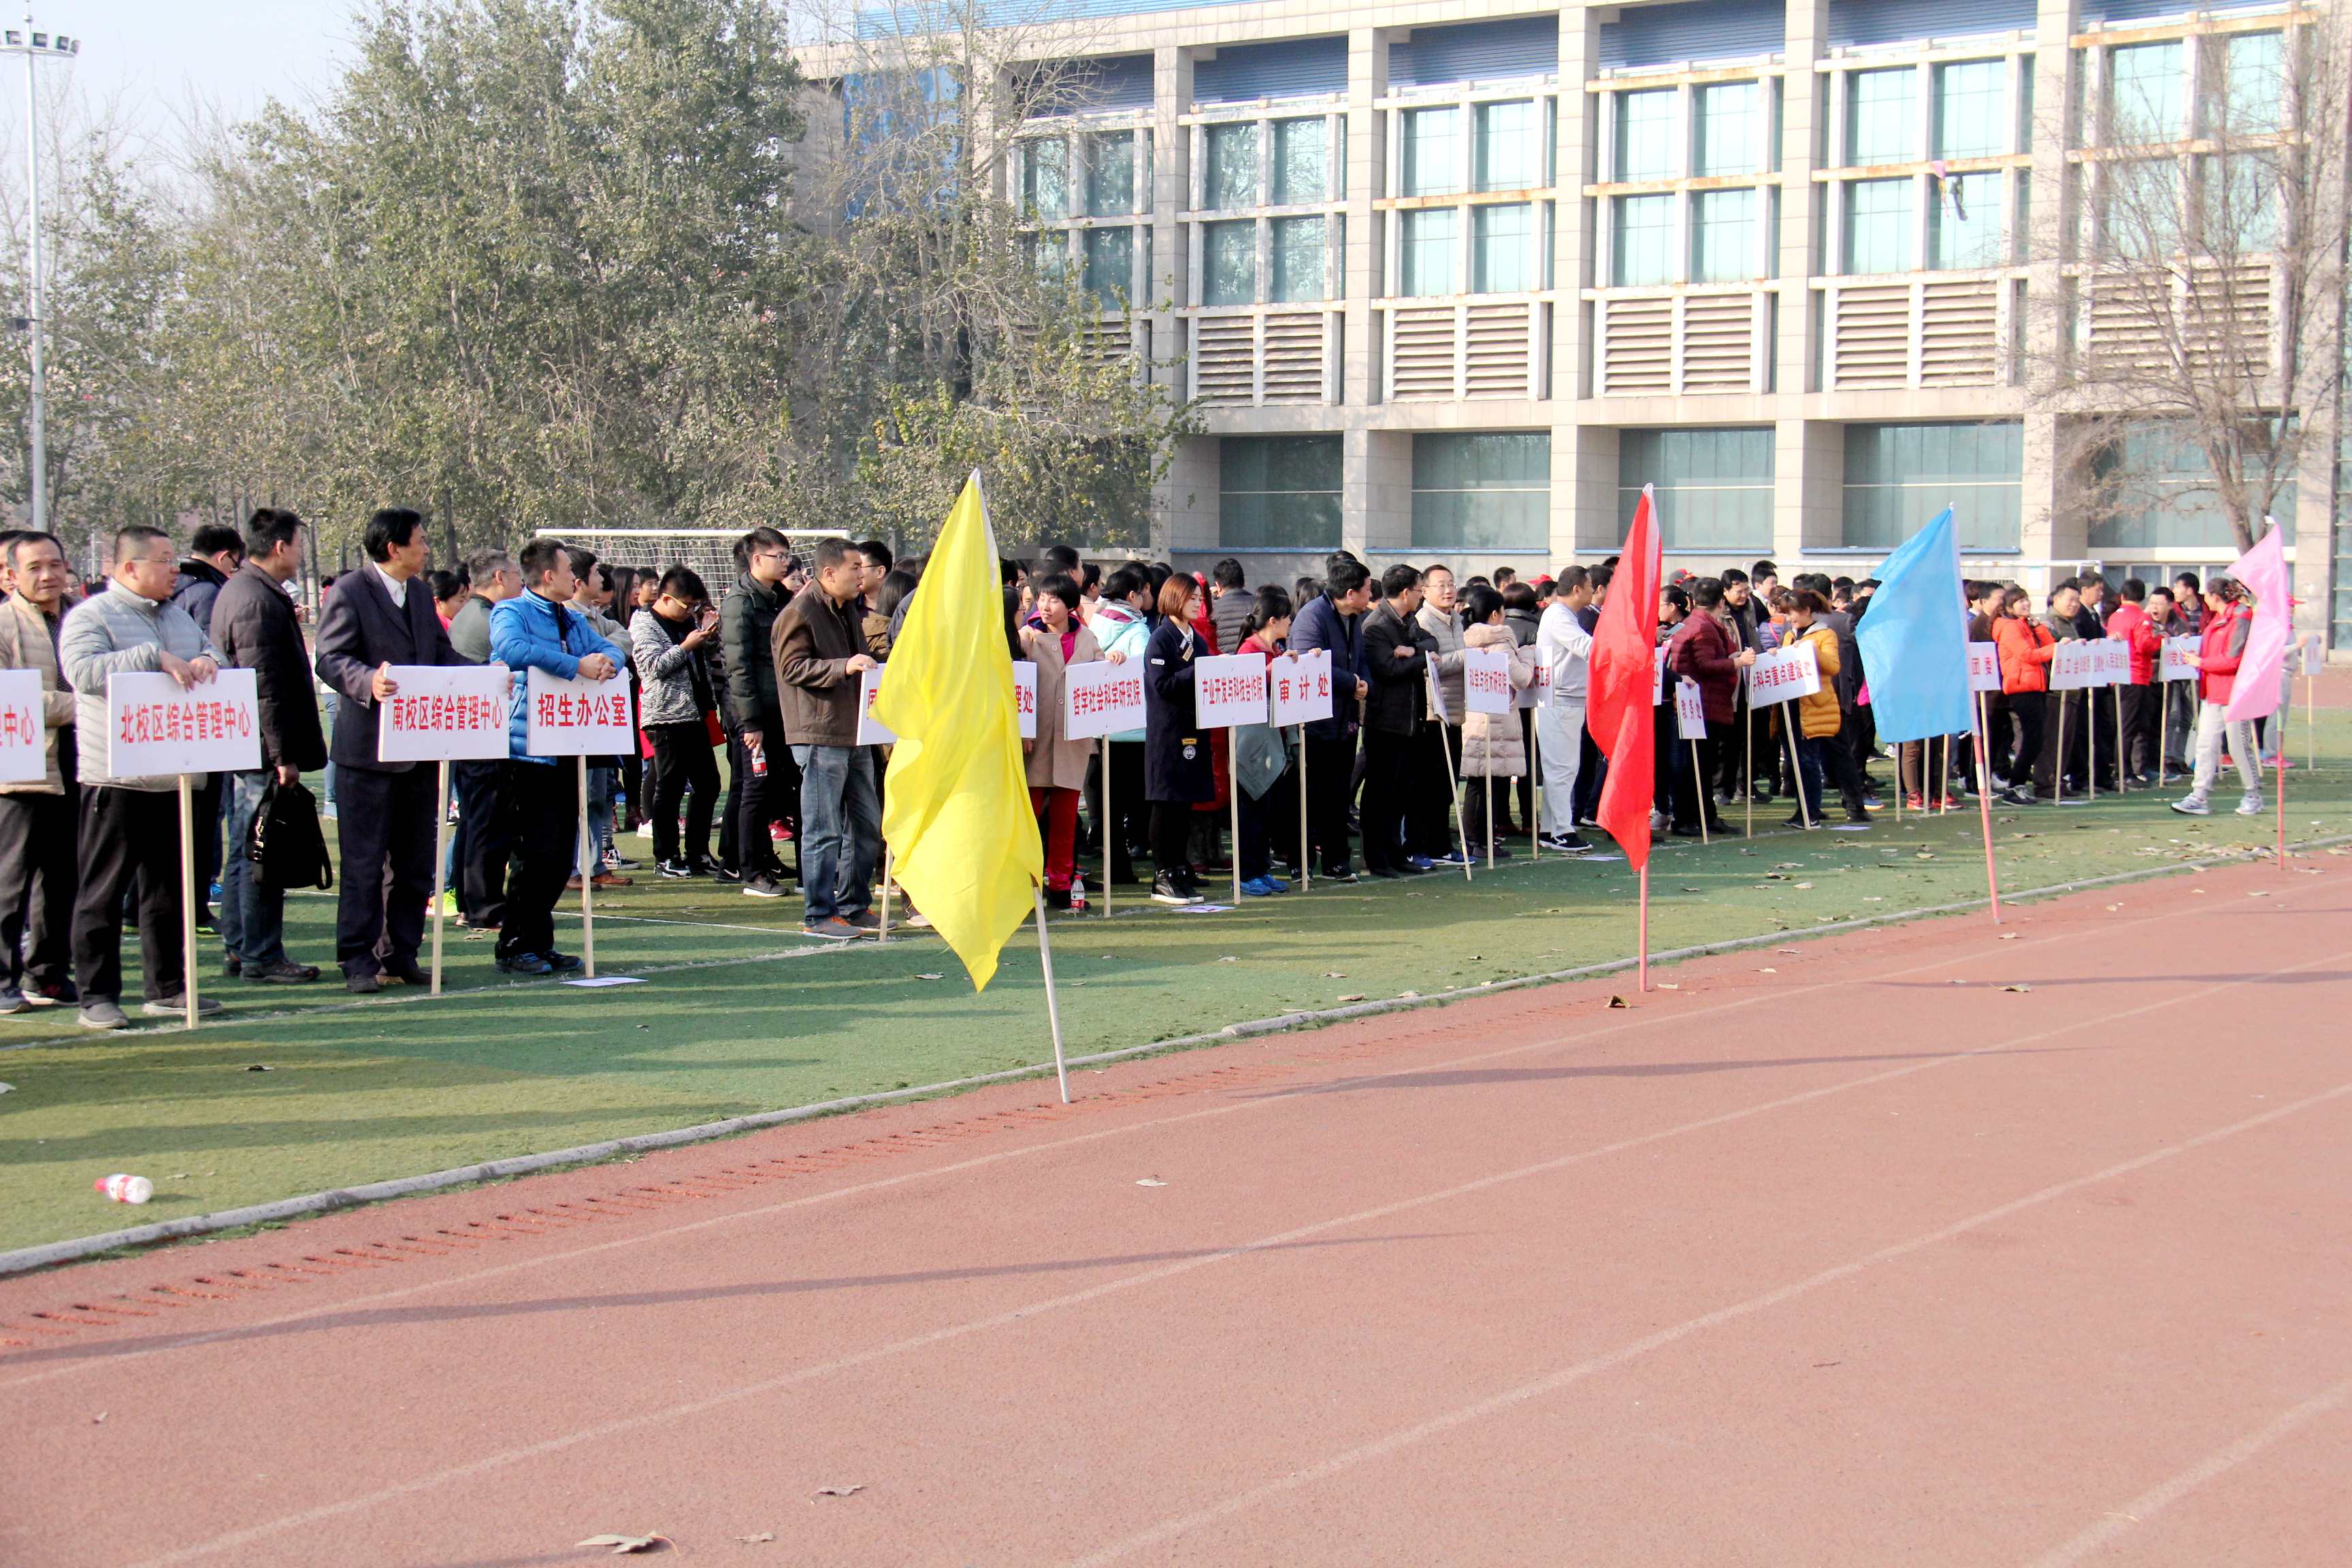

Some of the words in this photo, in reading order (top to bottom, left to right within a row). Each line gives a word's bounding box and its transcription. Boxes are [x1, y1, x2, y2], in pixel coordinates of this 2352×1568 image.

[1073, 677, 1142, 717] 哲学社会科学研究院
[1202, 674, 1263, 706] 产业开发与科技合作院
[1279, 672, 1329, 704] 审计处
[0, 704, 35, 747] 中心
[120, 700, 252, 744] 北校区综合管理中心
[392, 693, 503, 732] 南校区综合管理中心
[538, 692, 628, 728] 招生办公室
